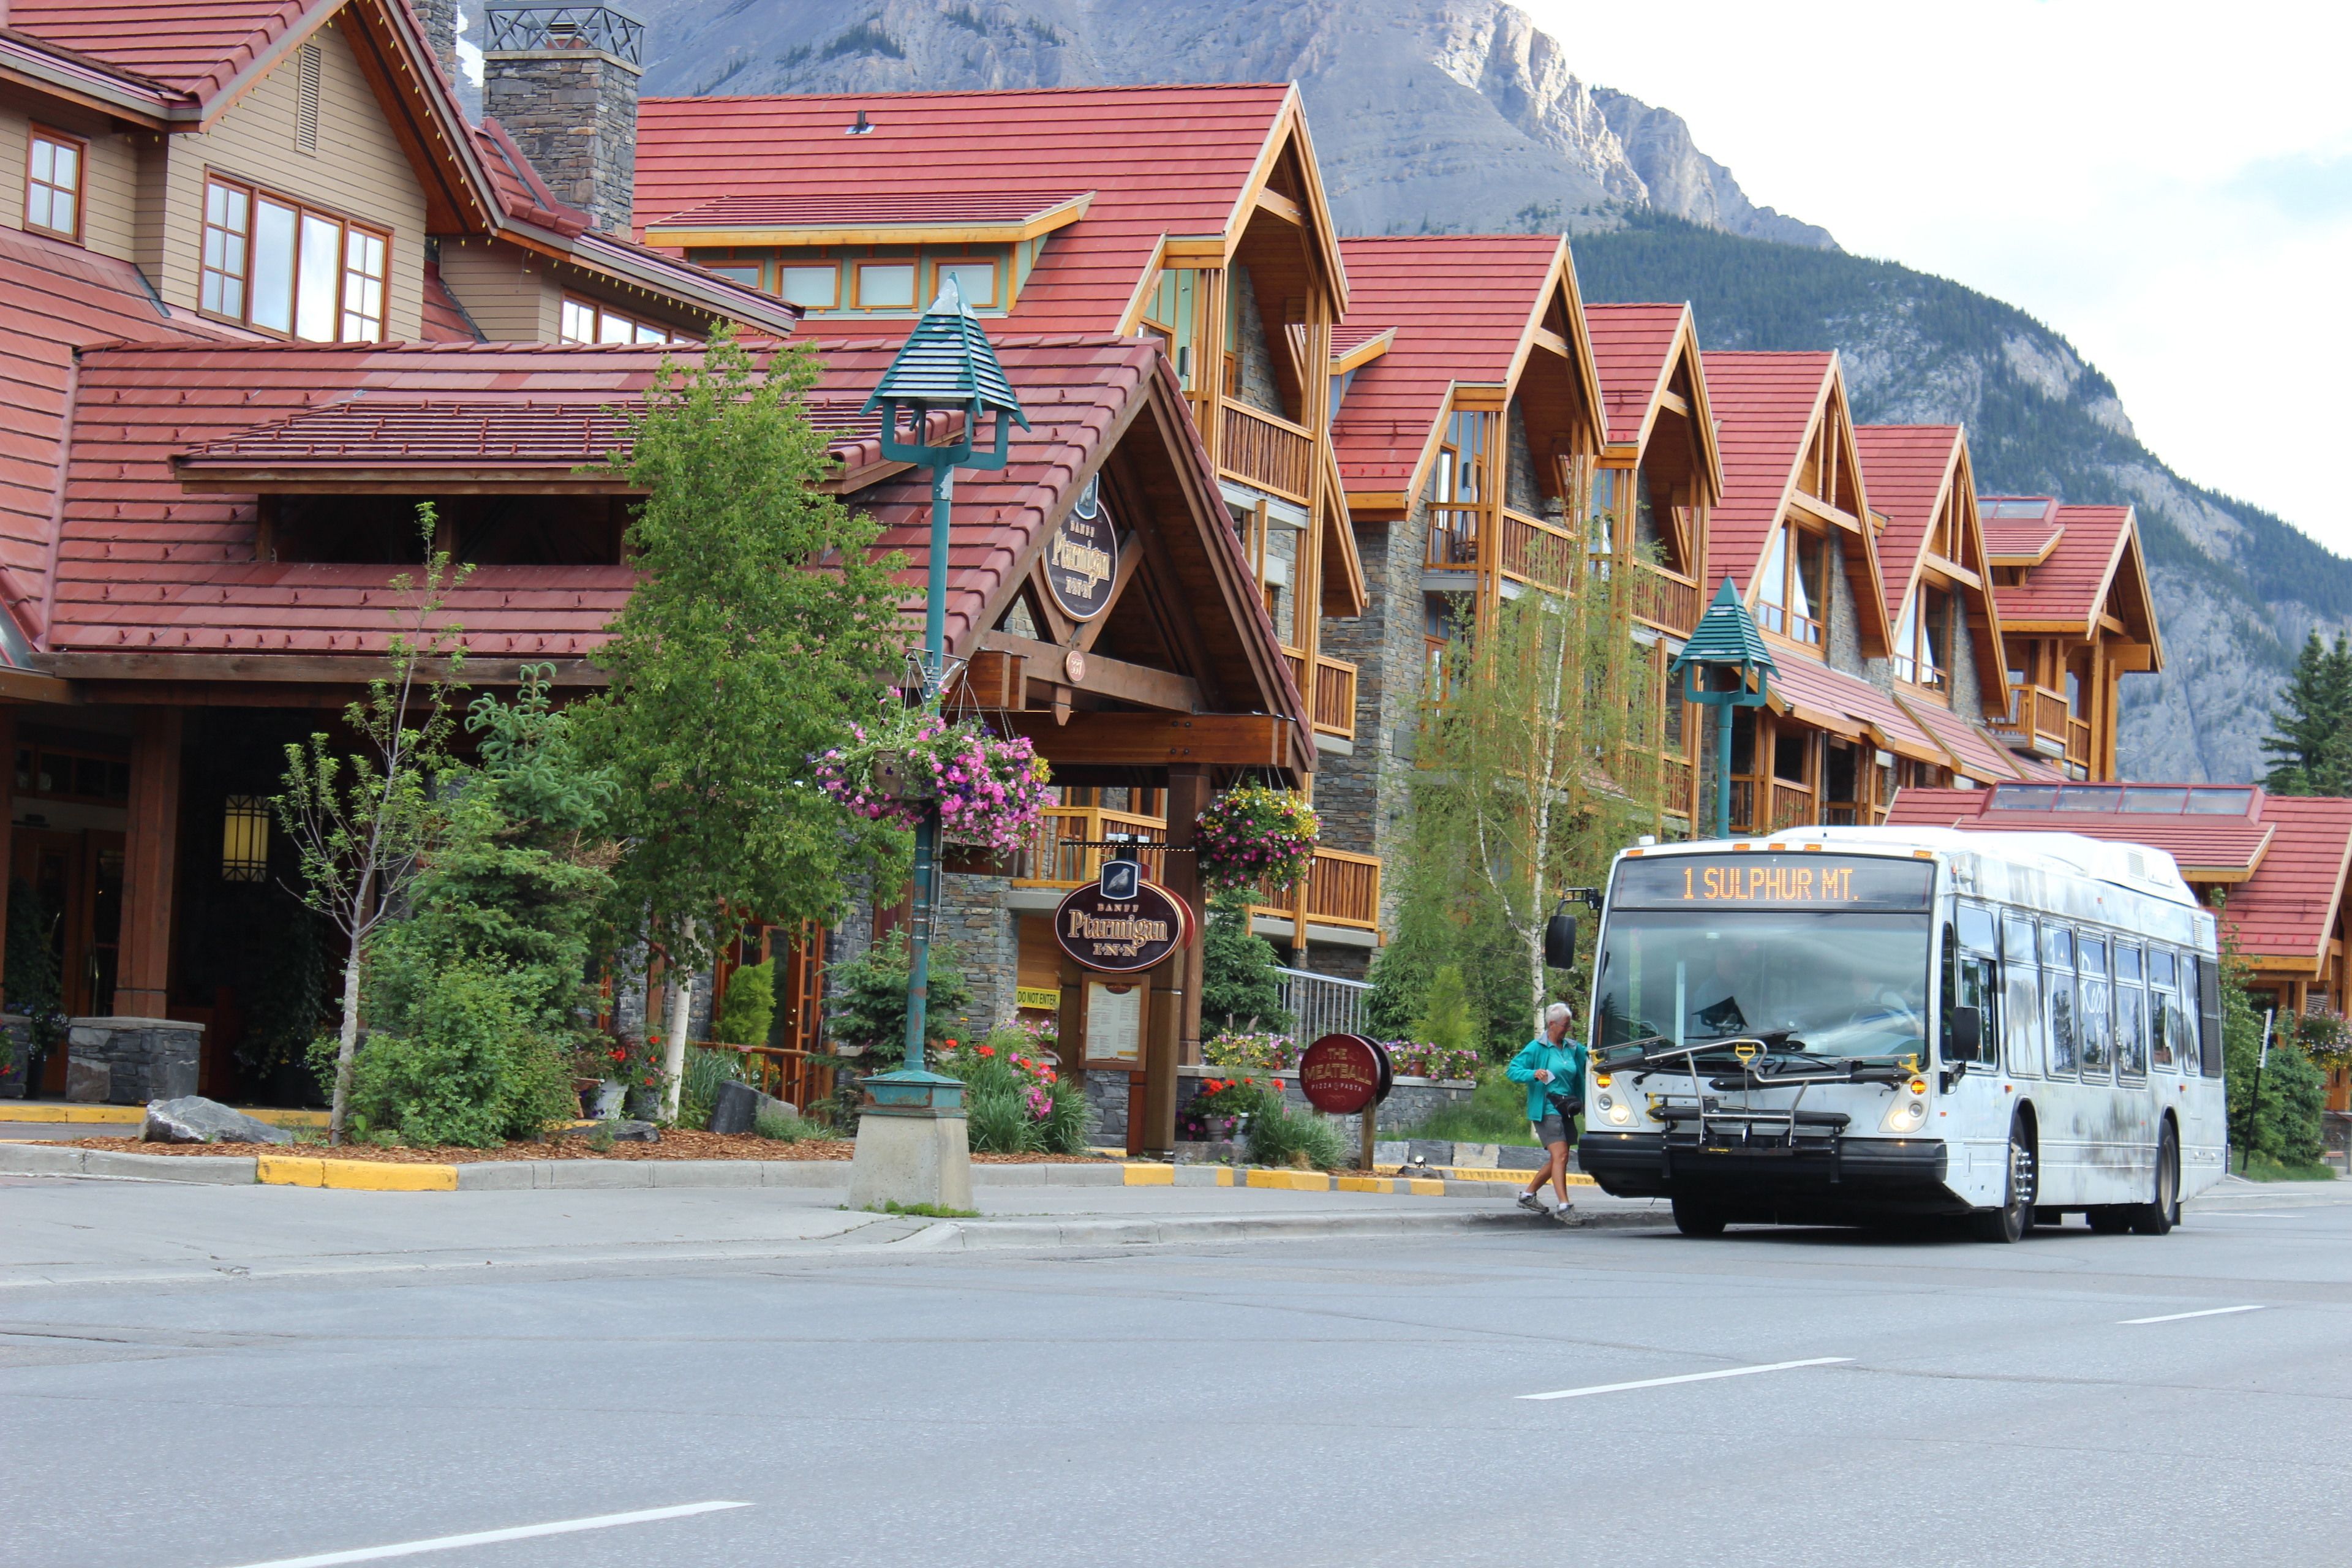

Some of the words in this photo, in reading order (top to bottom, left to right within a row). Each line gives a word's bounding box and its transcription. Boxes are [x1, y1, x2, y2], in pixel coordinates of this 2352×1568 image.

[1051, 527, 1110, 587] Ptarmigan
[1683, 867, 1695, 900] 1
[1703, 867, 1813, 900] SULPHUR
[1822, 868, 1860, 901] MT.
[1097, 903, 1139, 913] BANFF
[1068, 909, 1168, 948] Ptarmigan
[1017, 991, 1027, 1003] DO
[1027, 992, 1039, 1004] NOT
[1039, 993, 1057, 1005] ENTER
[1327, 1048, 1348, 1060] THE
[1304, 1063, 1372, 1086] MEATBALL
[1340, 1083, 1362, 1092] PASTA
